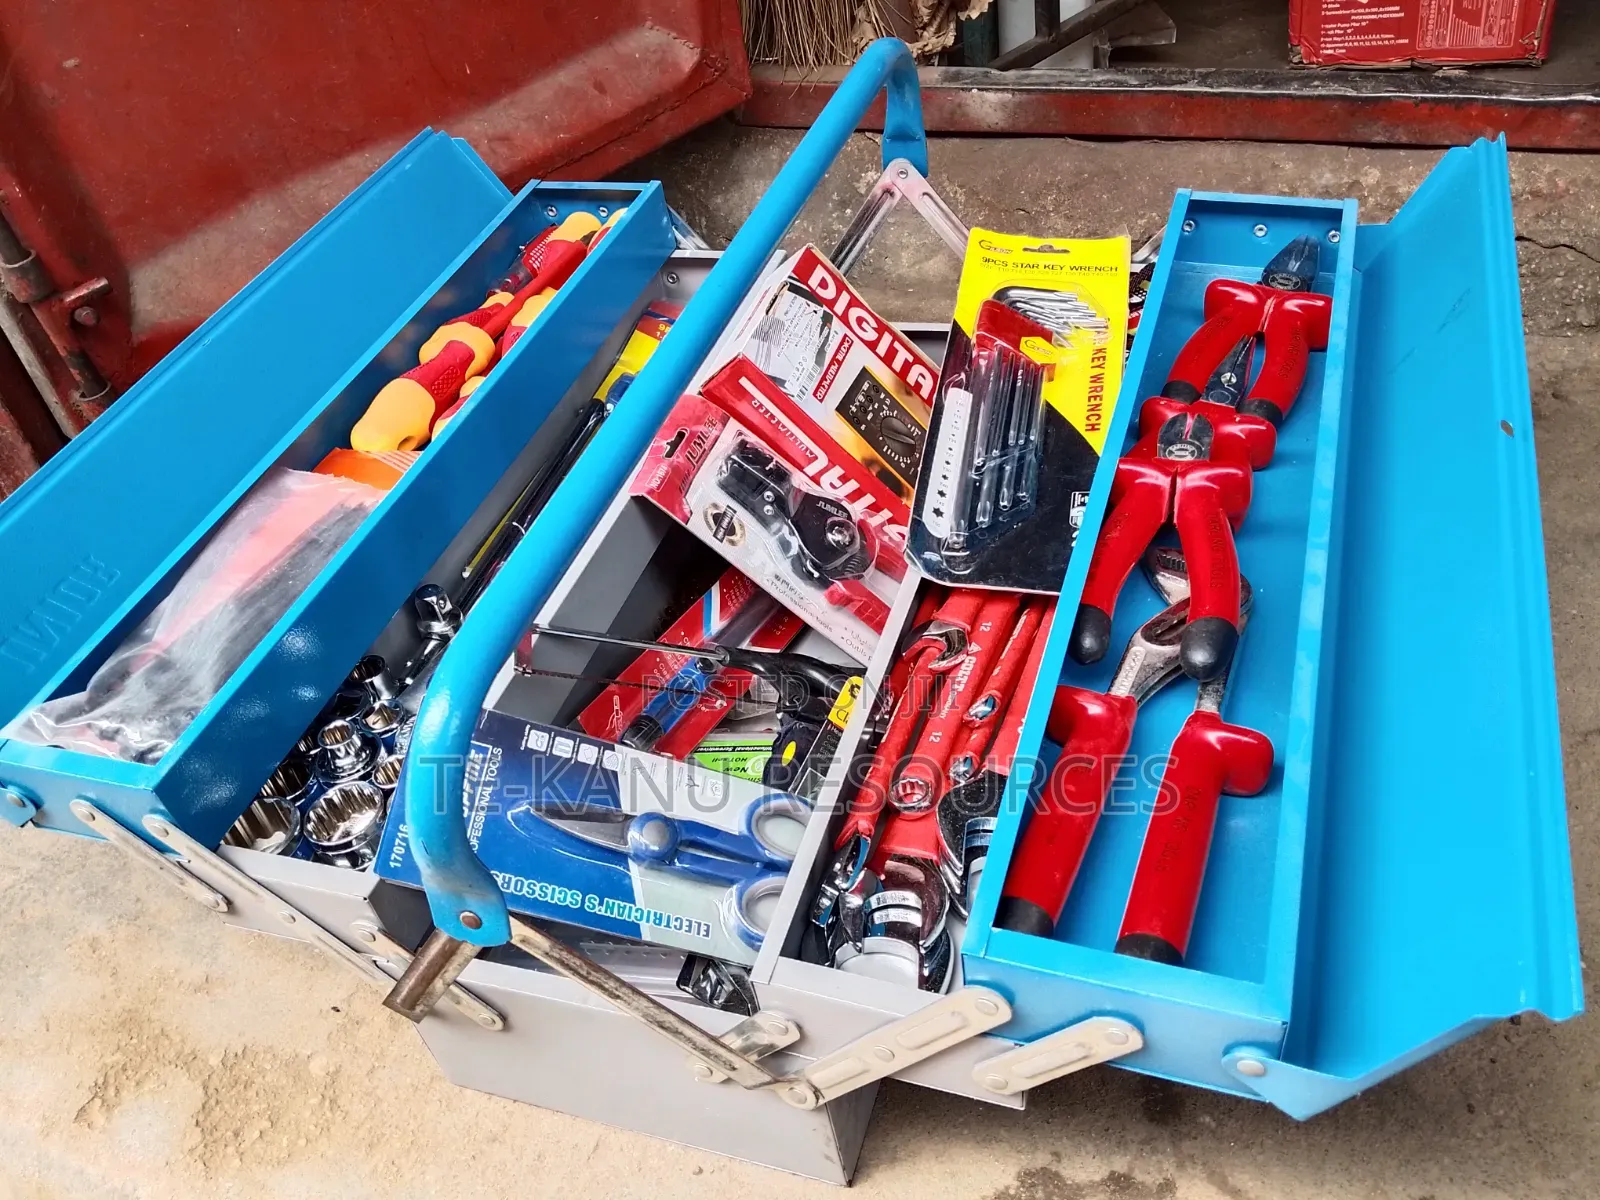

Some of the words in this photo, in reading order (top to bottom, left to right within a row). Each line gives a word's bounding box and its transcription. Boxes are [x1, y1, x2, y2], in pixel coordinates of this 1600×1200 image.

[982, 256, 1009, 268] 9PCS
[1044, 263, 1066, 271] KEY
[1091, 348, 1106, 369] KEY
[1085, 373, 1104, 431] WRENCH
[750, 399, 815, 459] MULTIMETER
[981, 621, 992, 631] 12
[930, 731, 942, 742] 12
[468, 784, 494, 854] OFESSIONAL
[485, 746, 504, 783] TOOLS
[388, 823, 412, 870] 170716
[584, 893, 711, 938] ELECTRICIAN'S
